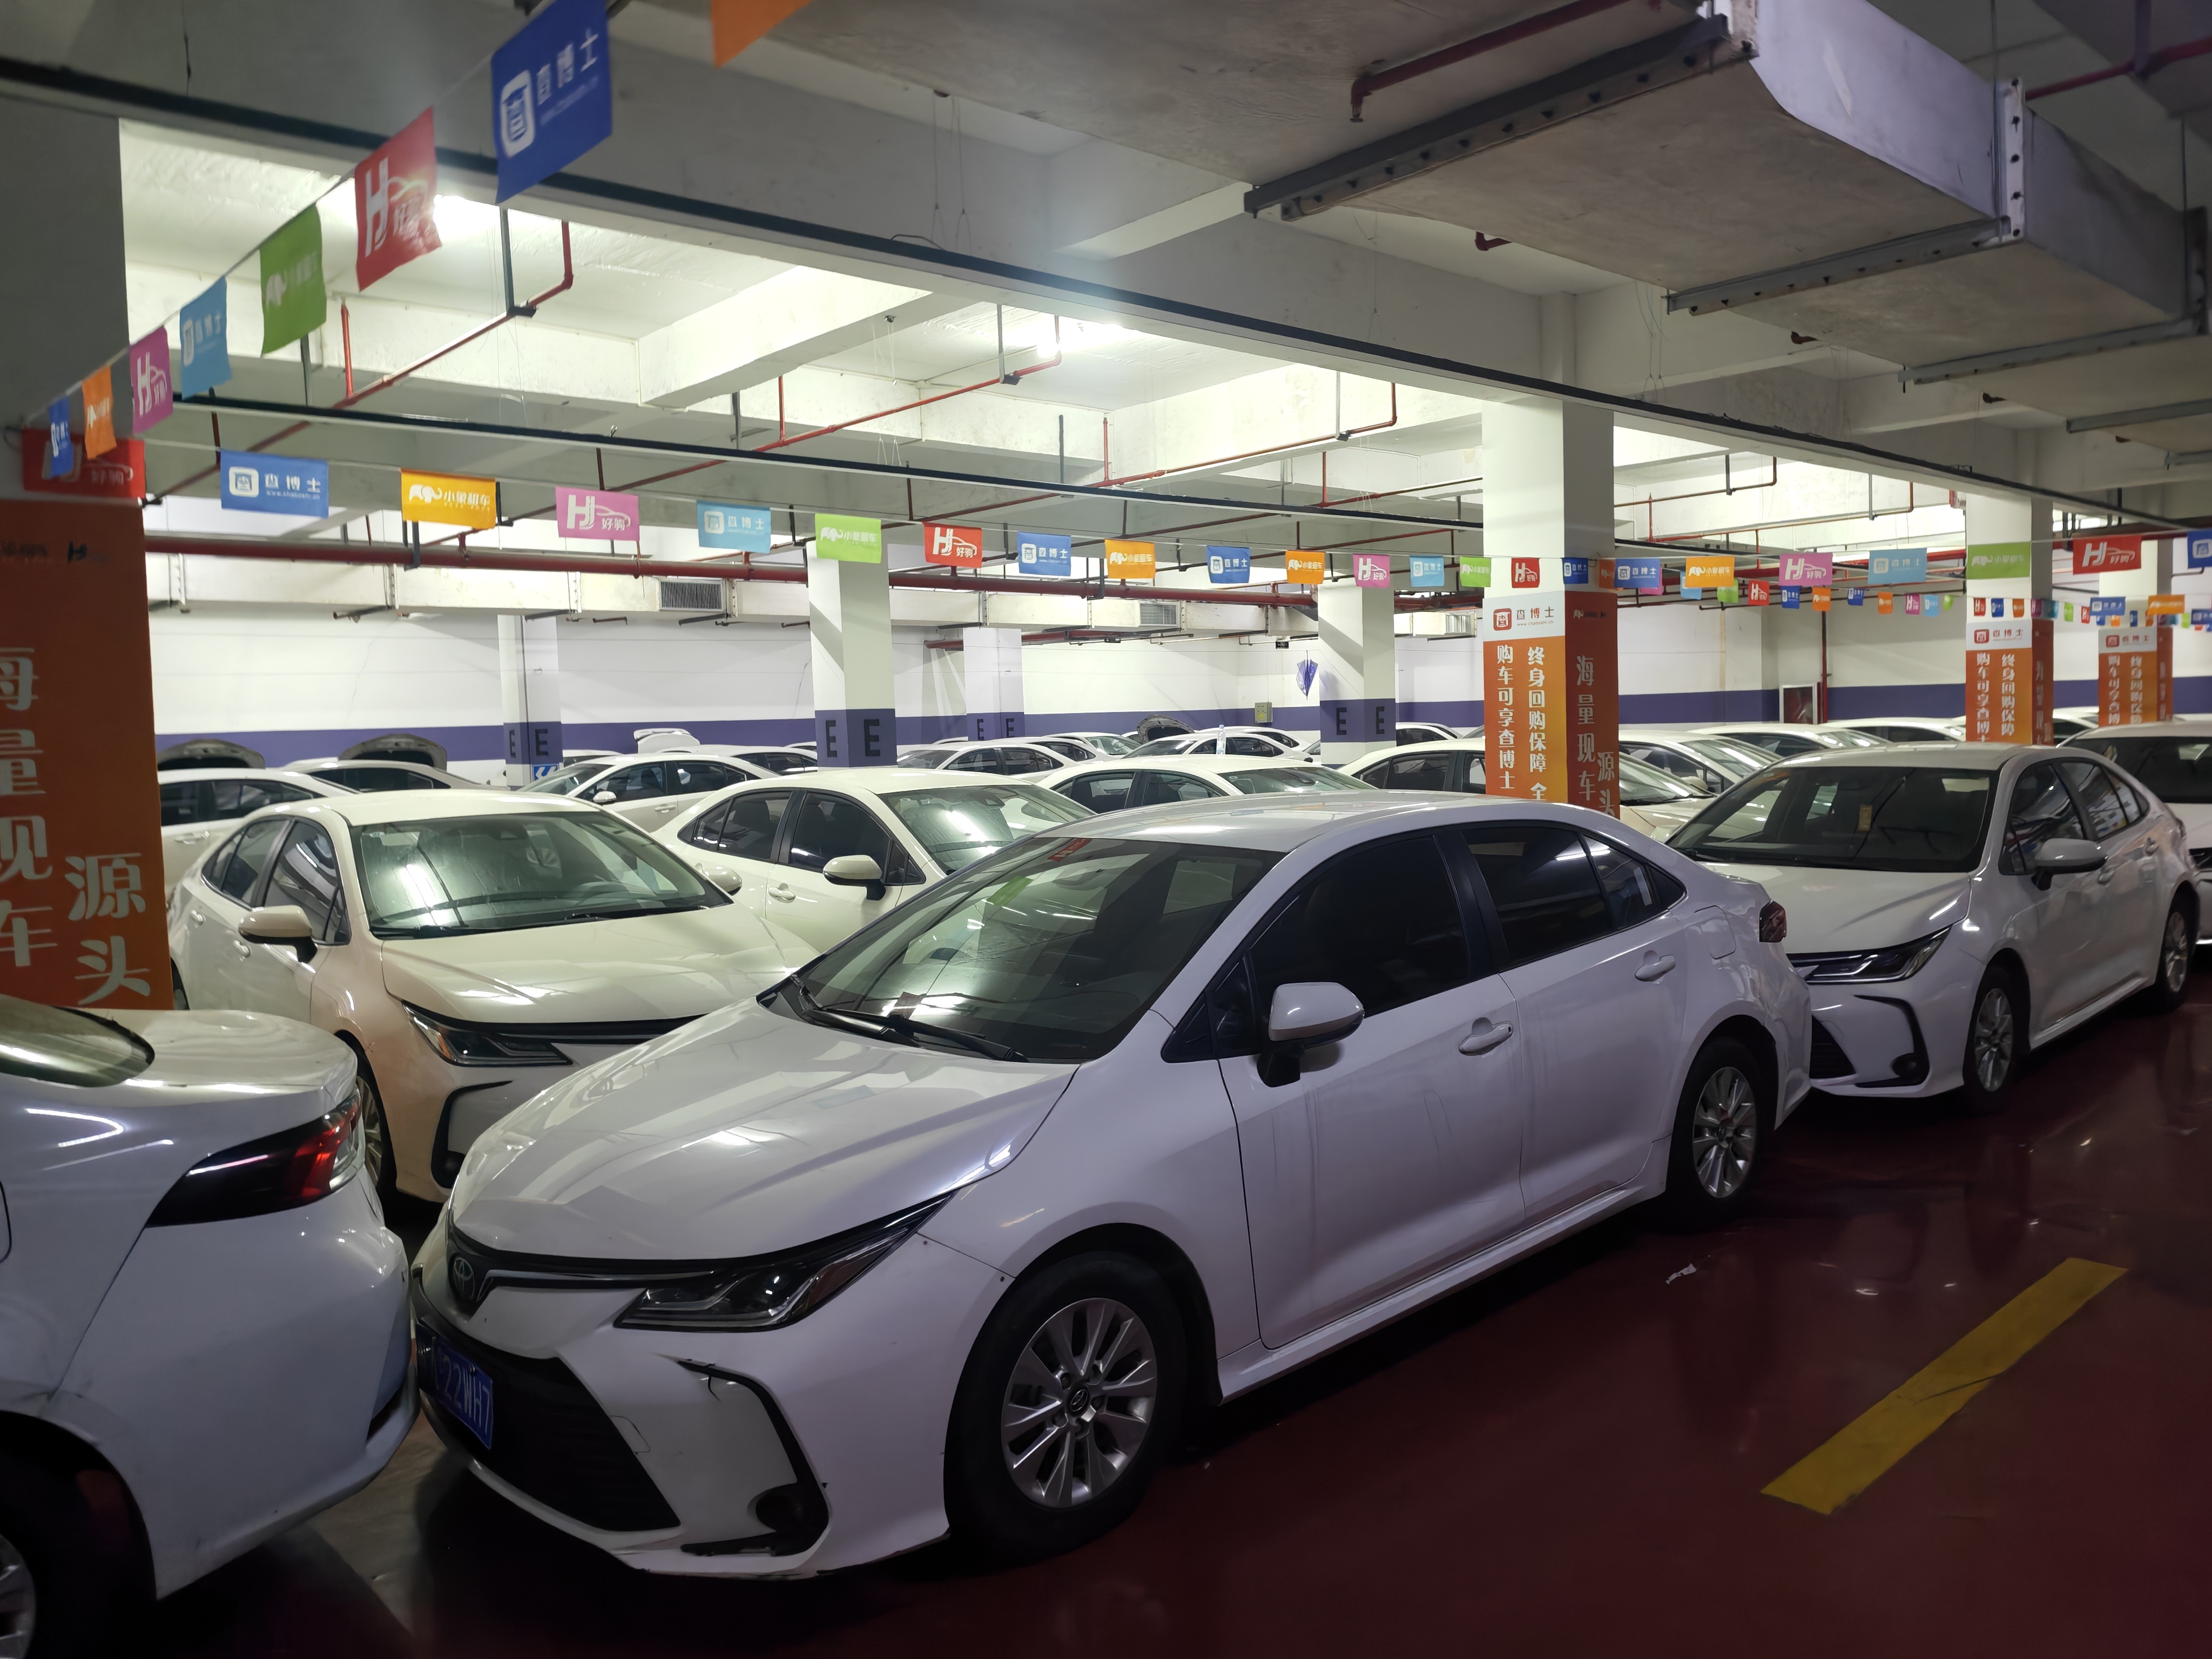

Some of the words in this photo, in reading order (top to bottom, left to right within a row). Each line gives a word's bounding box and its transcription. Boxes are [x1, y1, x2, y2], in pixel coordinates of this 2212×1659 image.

[1516, 606, 1554, 621] 查博士
[1336, 707, 1347, 736] E
[1375, 706, 1385, 734] E
[1497, 644, 1515, 790] 购车可享查博士
[1576, 655, 1596, 801] 海量现车
[509, 729, 516, 758] E
[534, 728, 549, 757] E
[825, 719, 838, 758] E
[864, 719, 881, 757] E
[64, 852, 151, 1006] 源头
